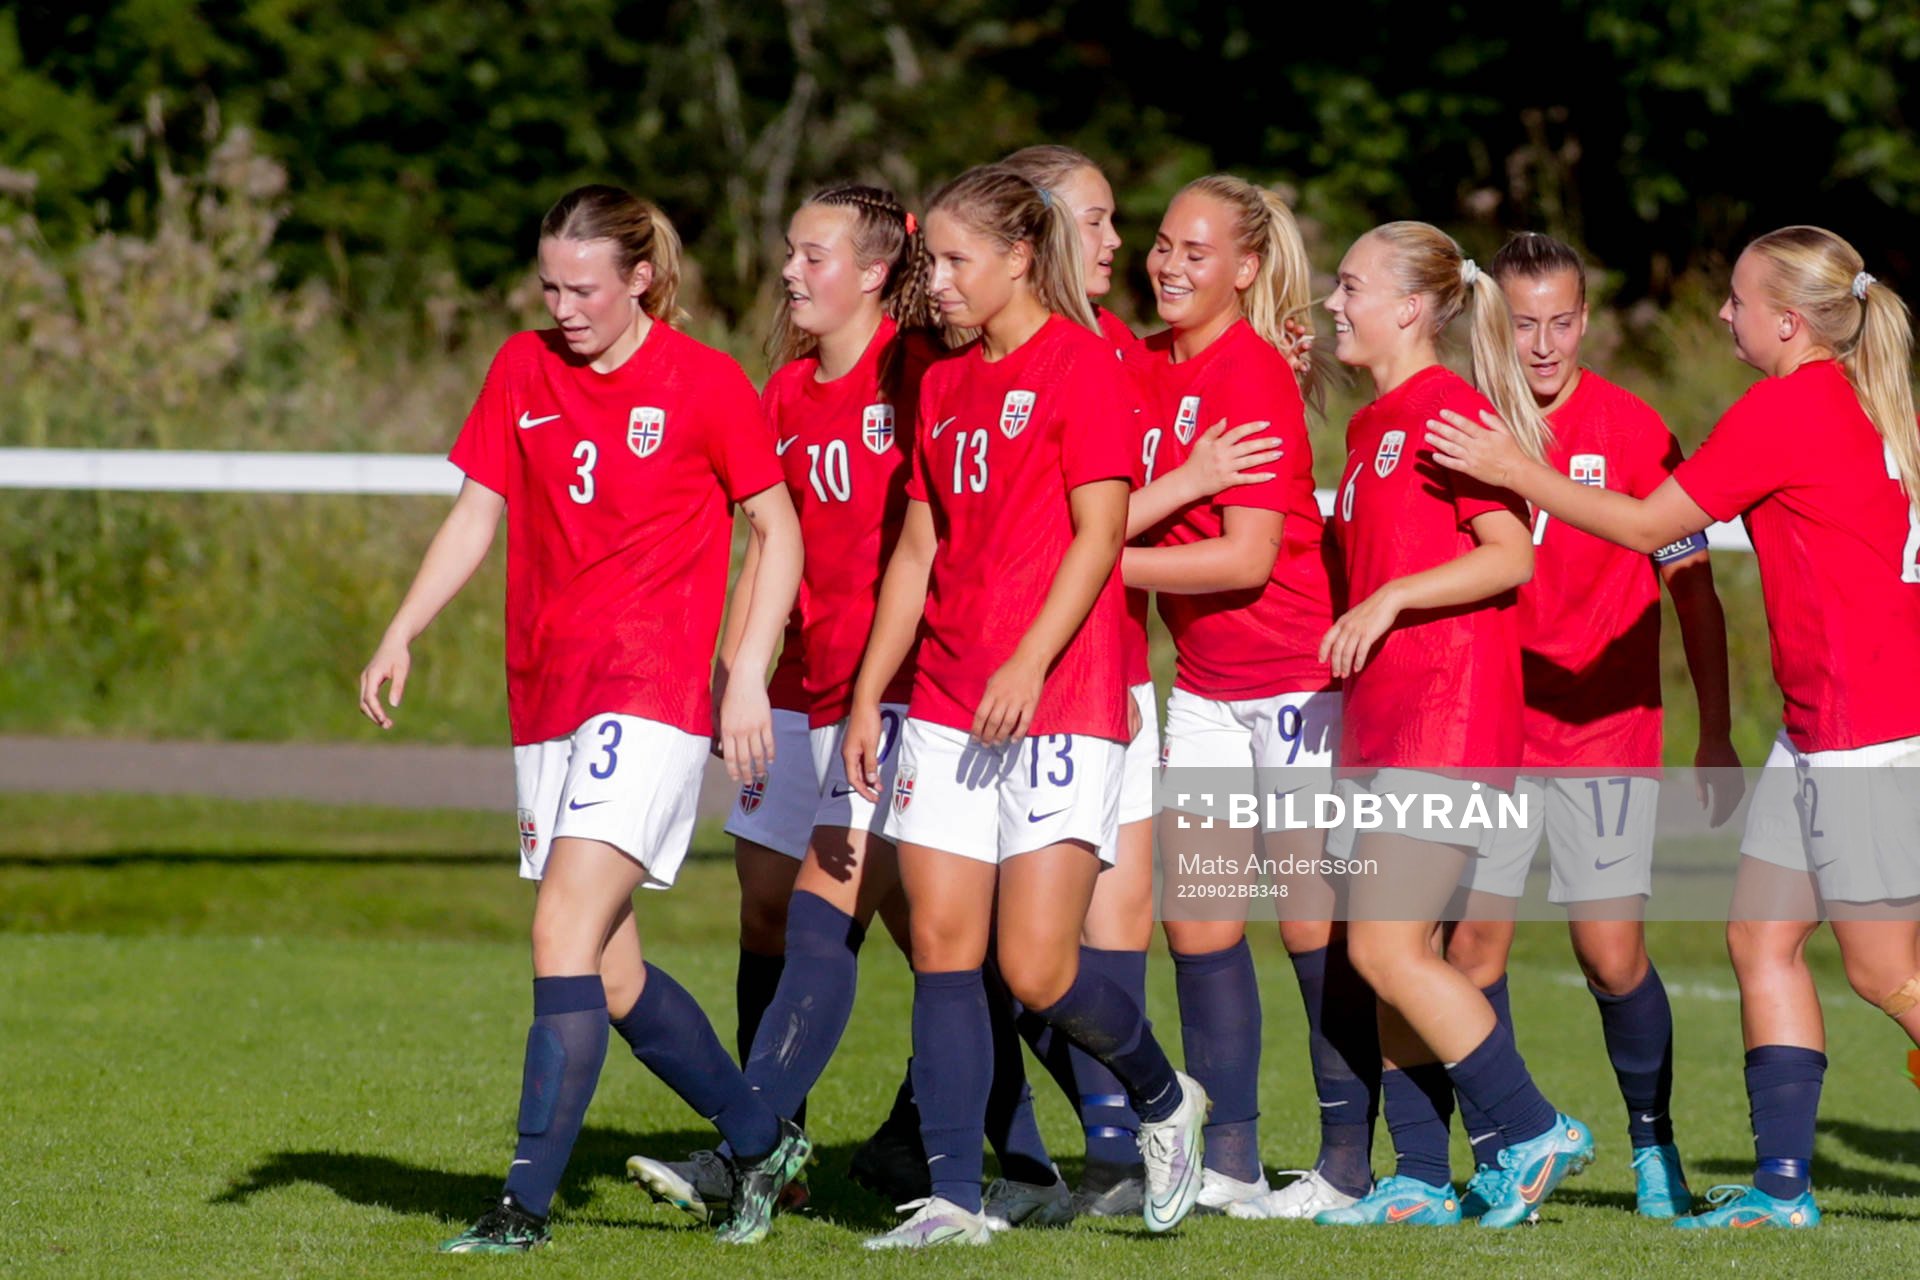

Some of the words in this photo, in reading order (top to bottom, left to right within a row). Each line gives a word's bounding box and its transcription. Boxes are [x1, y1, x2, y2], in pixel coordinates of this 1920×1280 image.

[568, 439, 598, 504] 3
[807, 438, 851, 503] 10
[952, 429, 988, 494] 13
[1142, 427, 1163, 487] 9
[1342, 462, 1364, 522] 6
[589, 719, 623, 780] 3
[1030, 733, 1075, 788] 13
[1277, 704, 1302, 765] 9
[1583, 777, 1632, 838] 17
